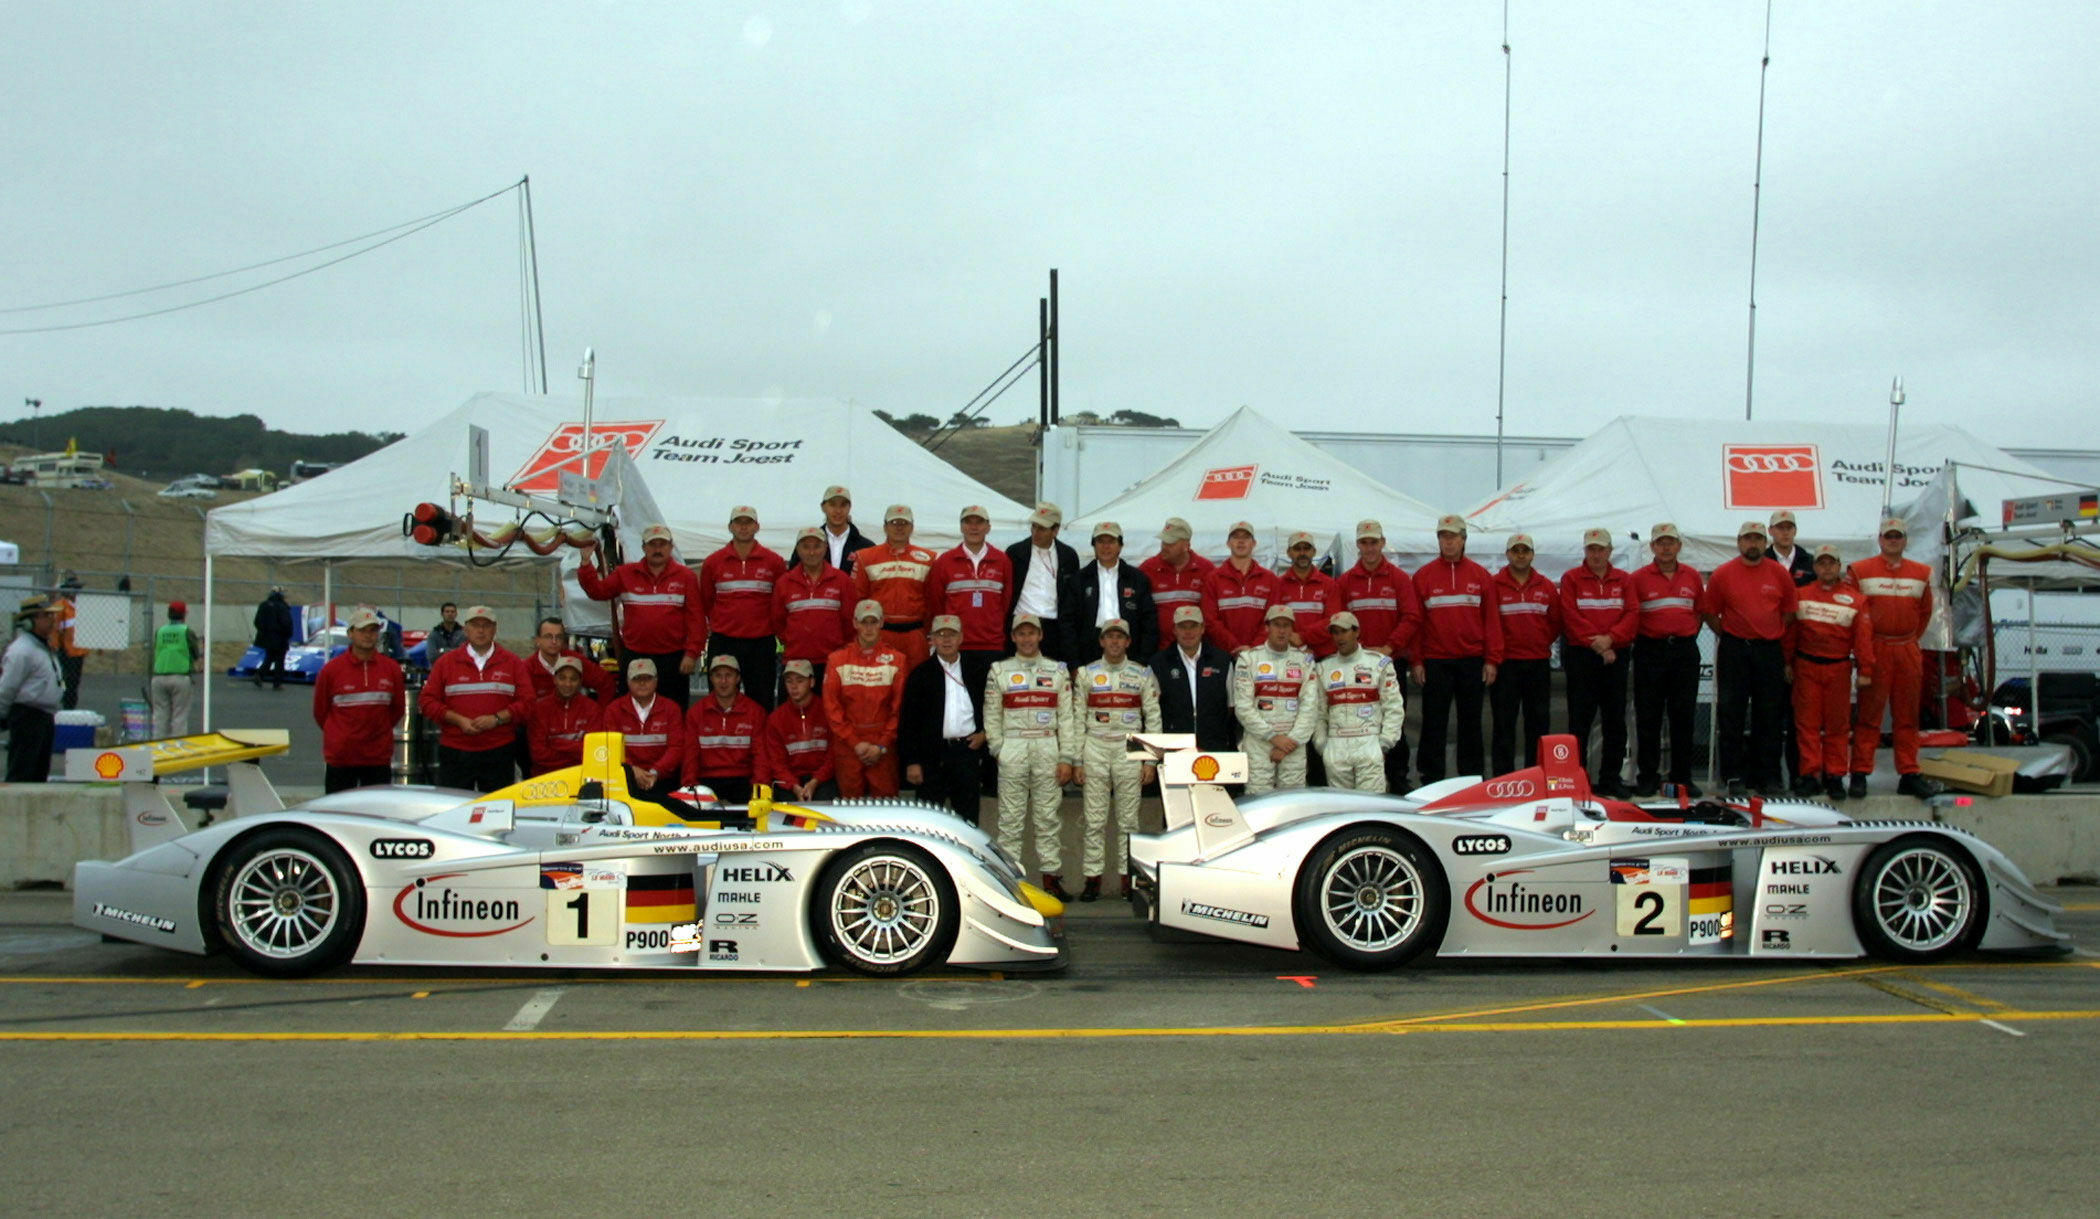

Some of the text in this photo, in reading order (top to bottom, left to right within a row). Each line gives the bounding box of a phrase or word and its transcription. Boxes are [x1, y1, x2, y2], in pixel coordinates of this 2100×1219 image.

[660, 436, 804, 452] Audi Sport
[653, 449, 795, 464] Team Joest
[1832, 460, 1942, 476] Audi Spor
[599, 829, 621, 837] Audi
[622, 830, 648, 840] Sport
[1631, 826, 1653, 835] Audi
[1654, 828, 1679, 837] Sport
[375, 842, 430, 856] LYCOS
[654, 840, 784, 853] www.audiusa.com
[1457, 838, 1507, 852] LYCOS
[723, 866, 794, 882] HELIX
[1771, 860, 1842, 875] HELIX
[1486, 873, 1582, 913] Infineon
[1767, 884, 1810, 895] MAHLE
[415, 878, 520, 920] Infineon
[718, 892, 761, 903] MAHLE
[103, 906, 176, 930] MICHELIN
[567, 893, 588, 938] 1
[1192, 904, 1269, 926] MICHELIN
[1633, 891, 1665, 935] 2
[1690, 919, 1720, 939] P900
[1762, 930, 1790, 942] R
[626, 930, 669, 949] P900
[709, 940, 738, 953] R
